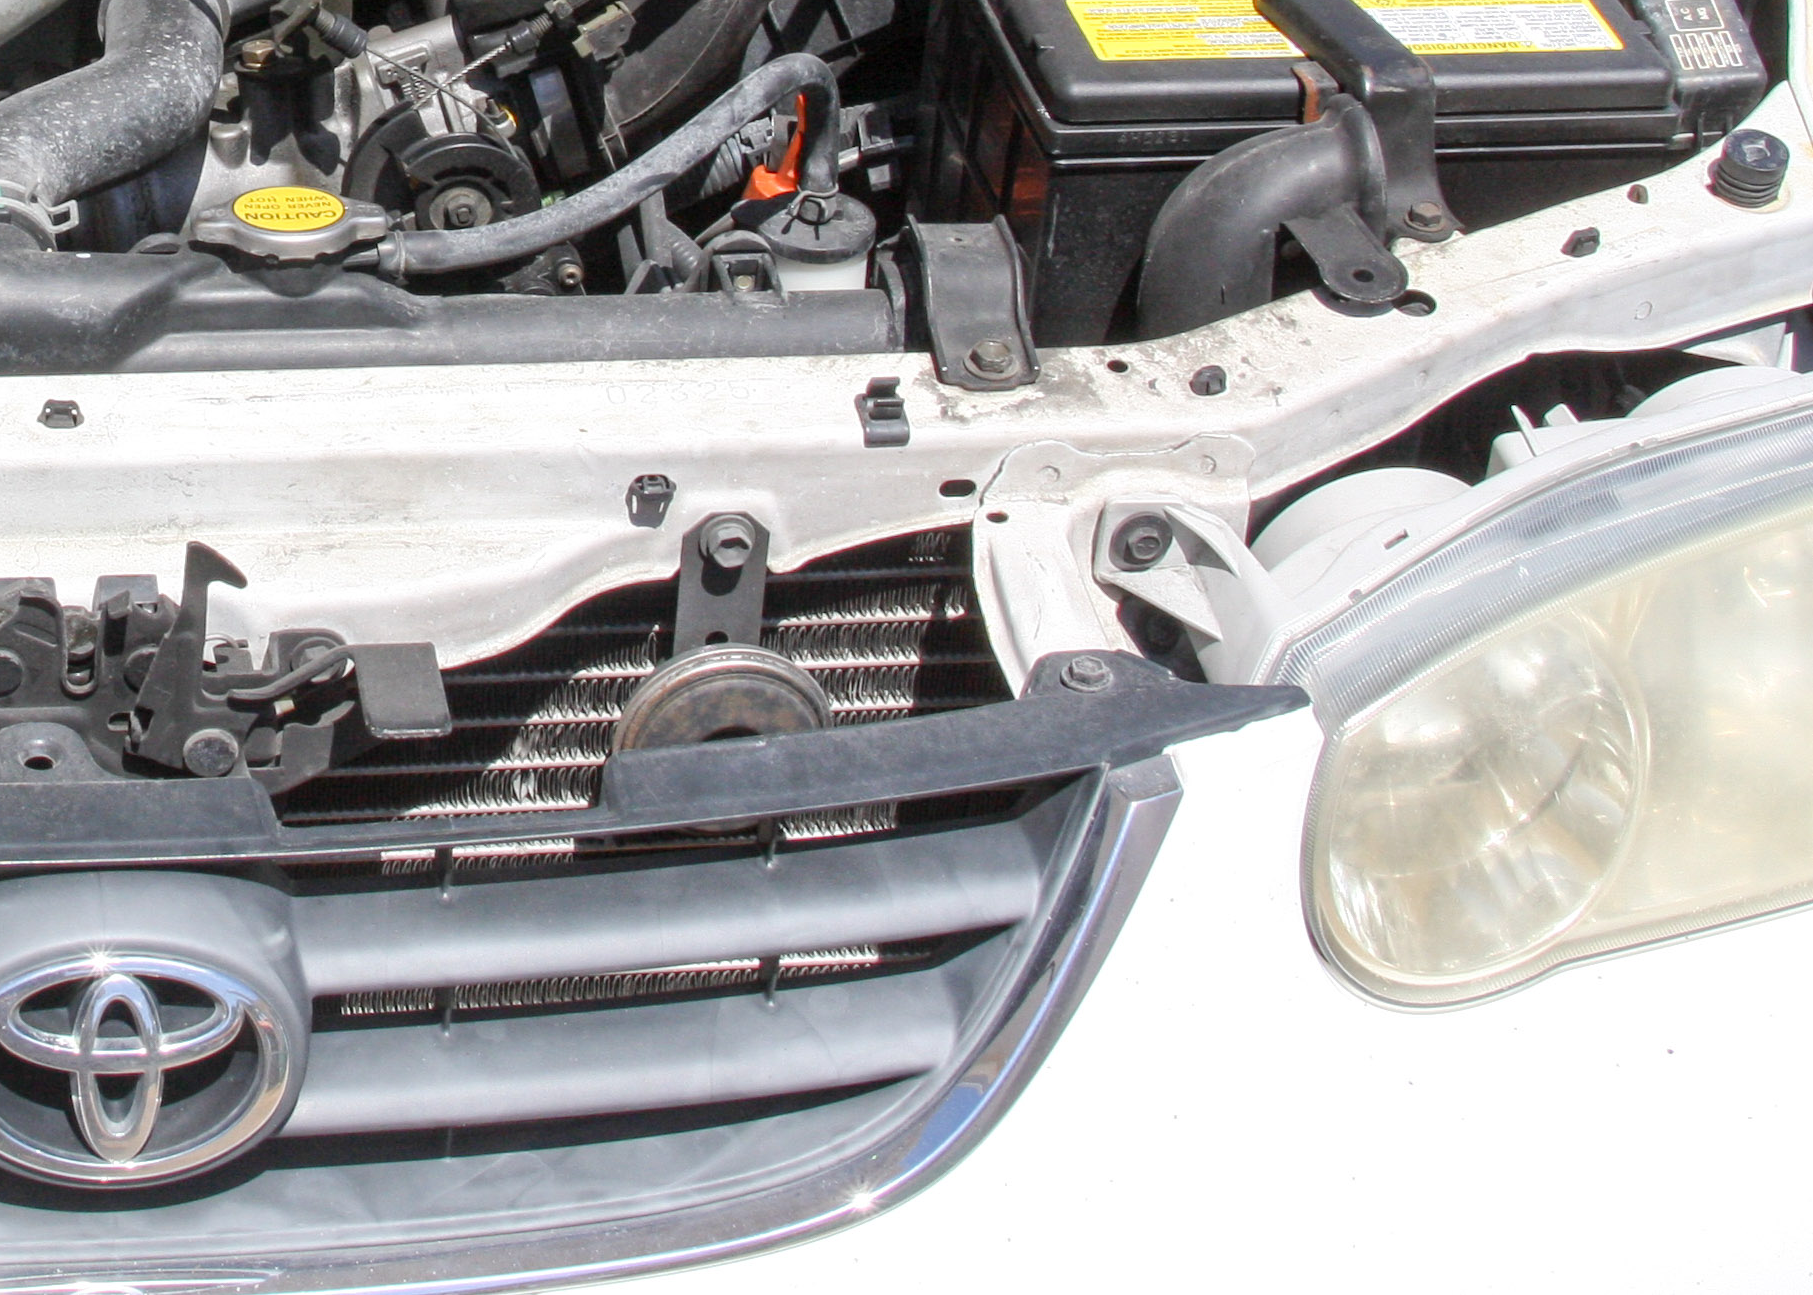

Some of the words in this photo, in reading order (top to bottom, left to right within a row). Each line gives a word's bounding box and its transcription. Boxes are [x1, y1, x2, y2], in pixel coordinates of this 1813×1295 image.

[285, 195, 329, 203] WHEN
[287, 201, 331, 209] NEVER
[244, 209, 337, 220] CAUTION
